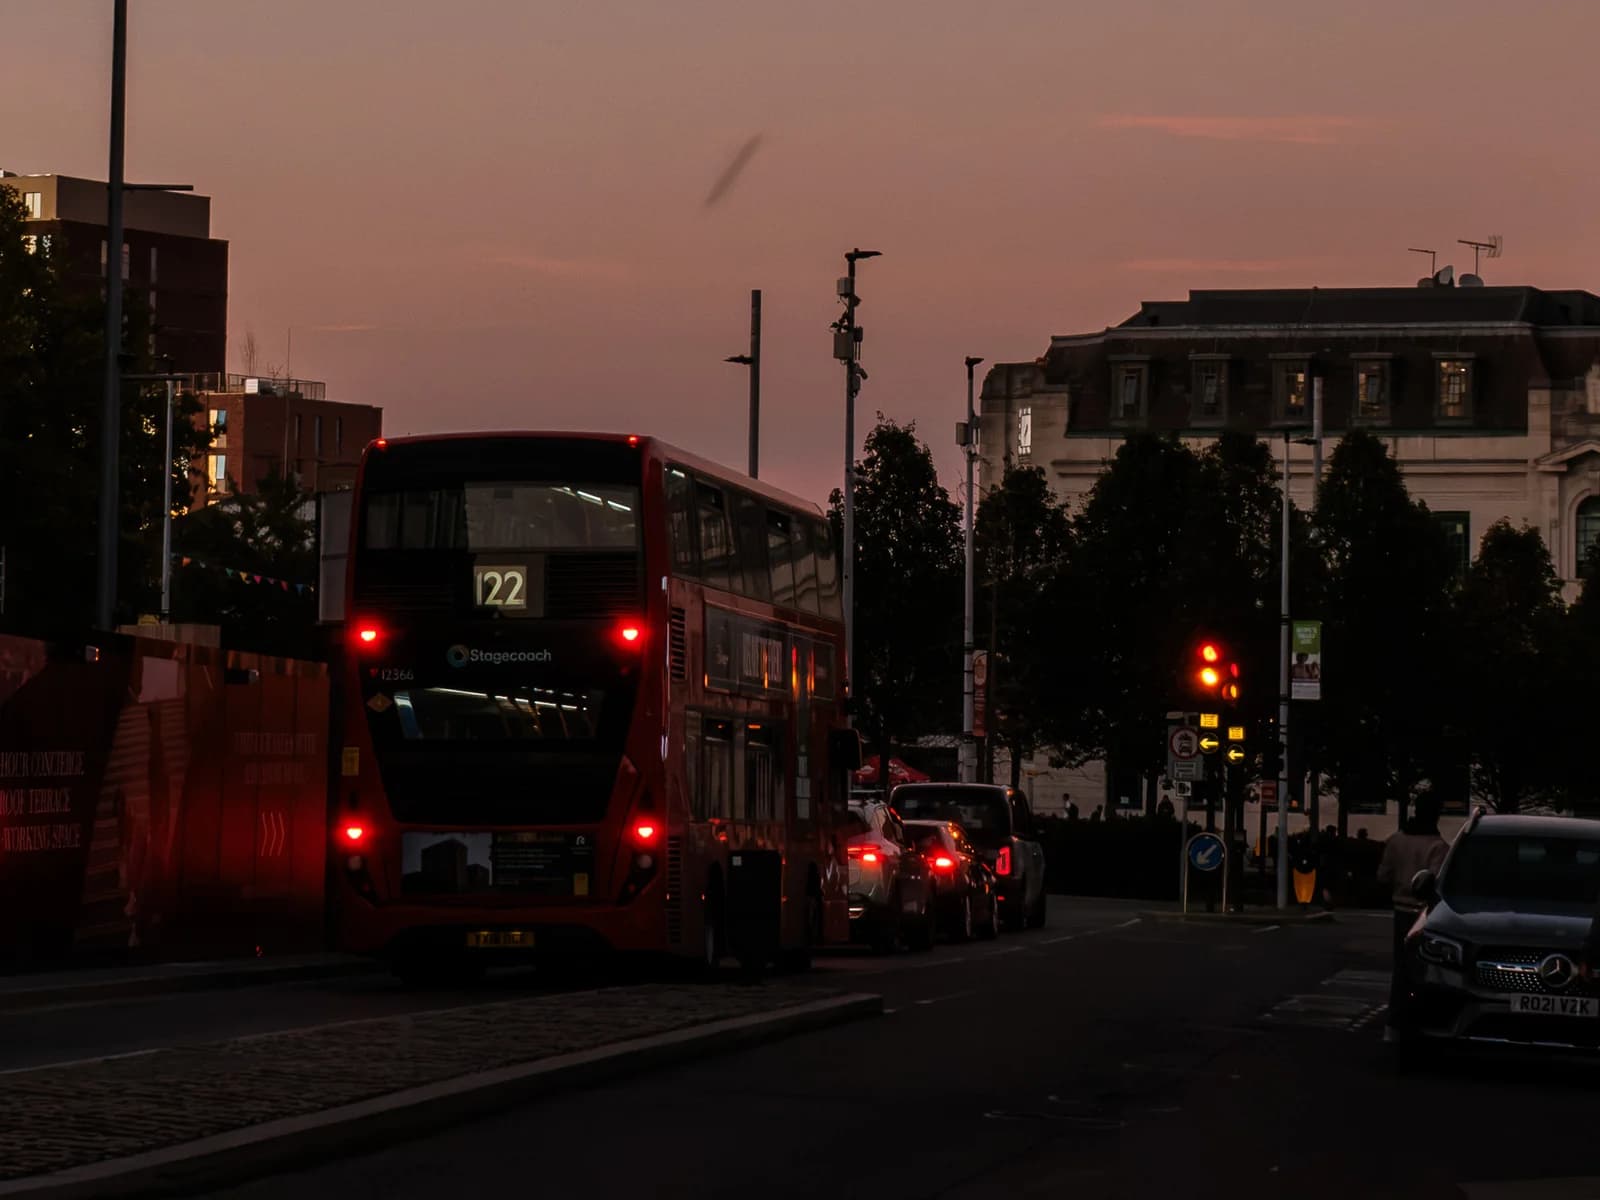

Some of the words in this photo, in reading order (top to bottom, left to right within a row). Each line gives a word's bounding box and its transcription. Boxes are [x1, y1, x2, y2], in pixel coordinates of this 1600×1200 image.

[476, 570, 525, 606] 122
[469, 648, 552, 664] Stagecoach
[28, 786, 73, 814] TERRACE
